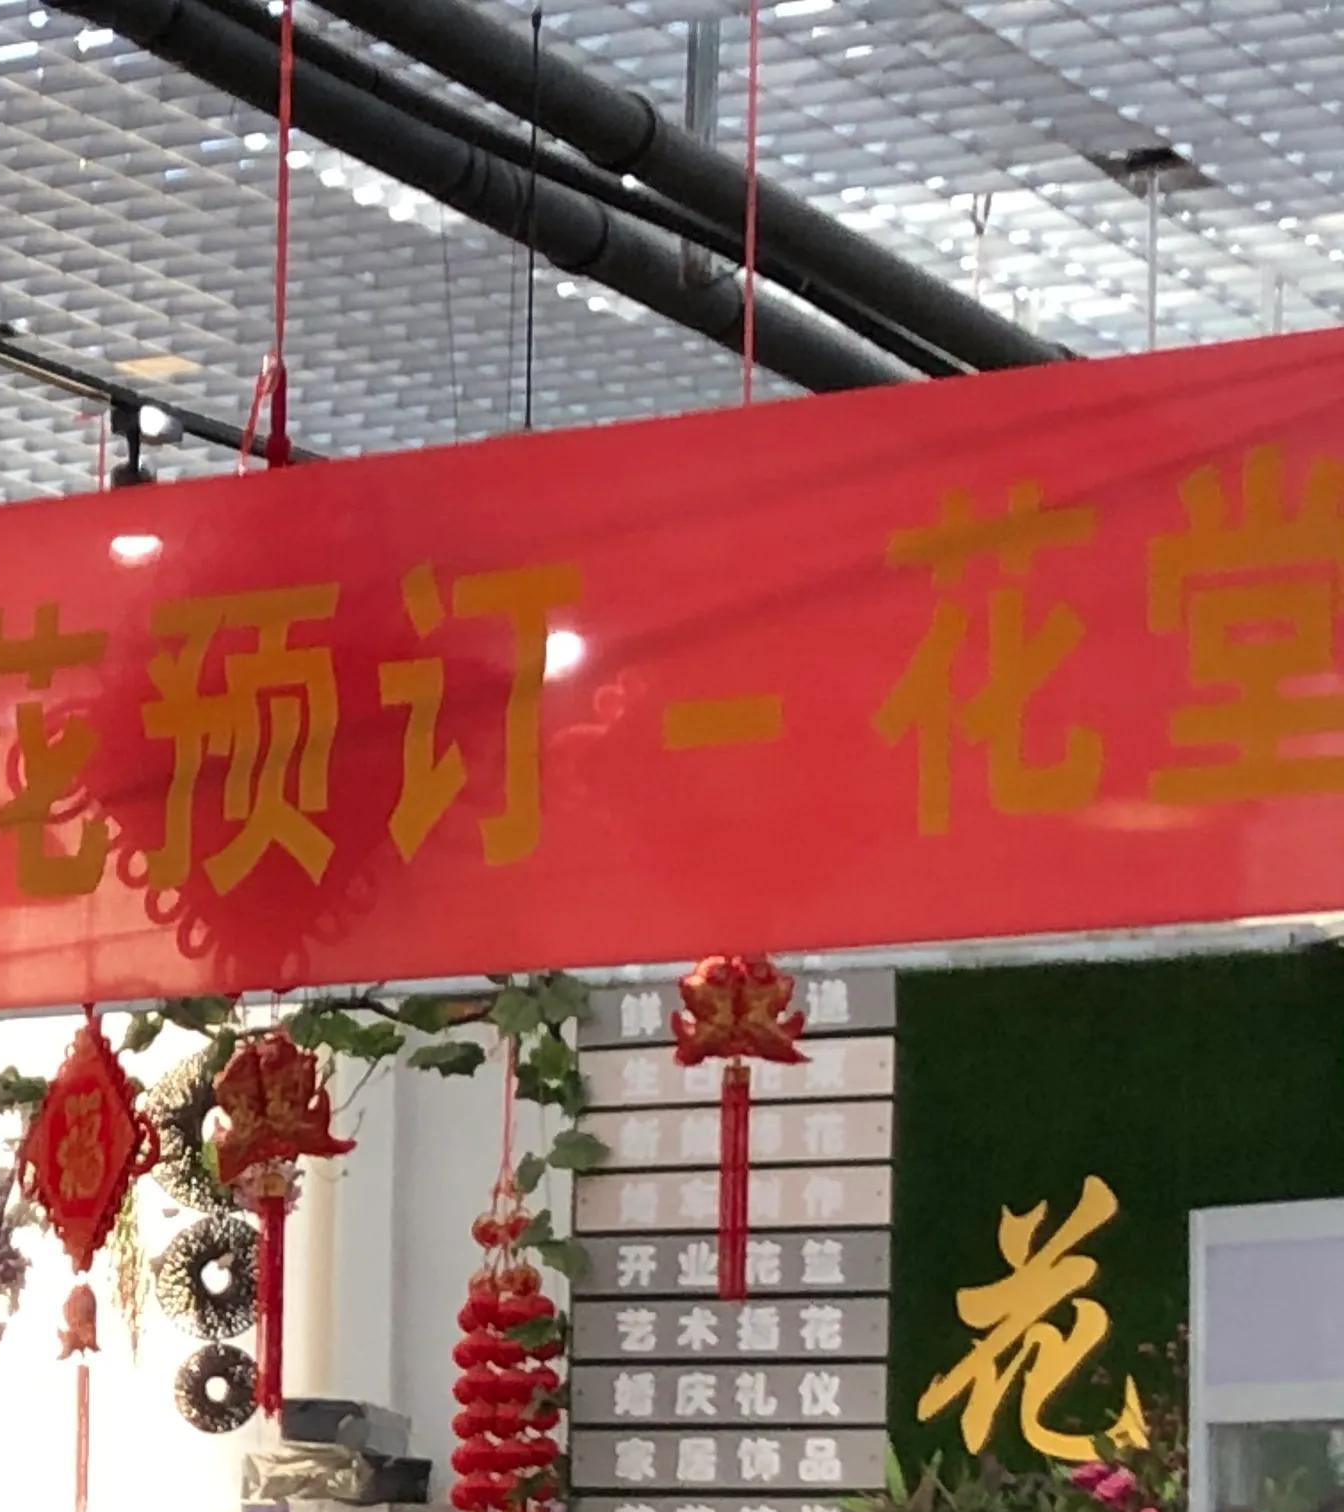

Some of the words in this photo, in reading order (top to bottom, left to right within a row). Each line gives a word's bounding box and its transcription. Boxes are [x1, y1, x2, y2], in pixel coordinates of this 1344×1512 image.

[616, 1239, 845, 1288] 开业花篮
[615, 1305, 843, 1351] 艺术插花
[917, 1174, 1150, 1463] 花
[613, 1371, 842, 1417] 婚庆礼仪
[614, 1437, 842, 1482] 家居饰品
